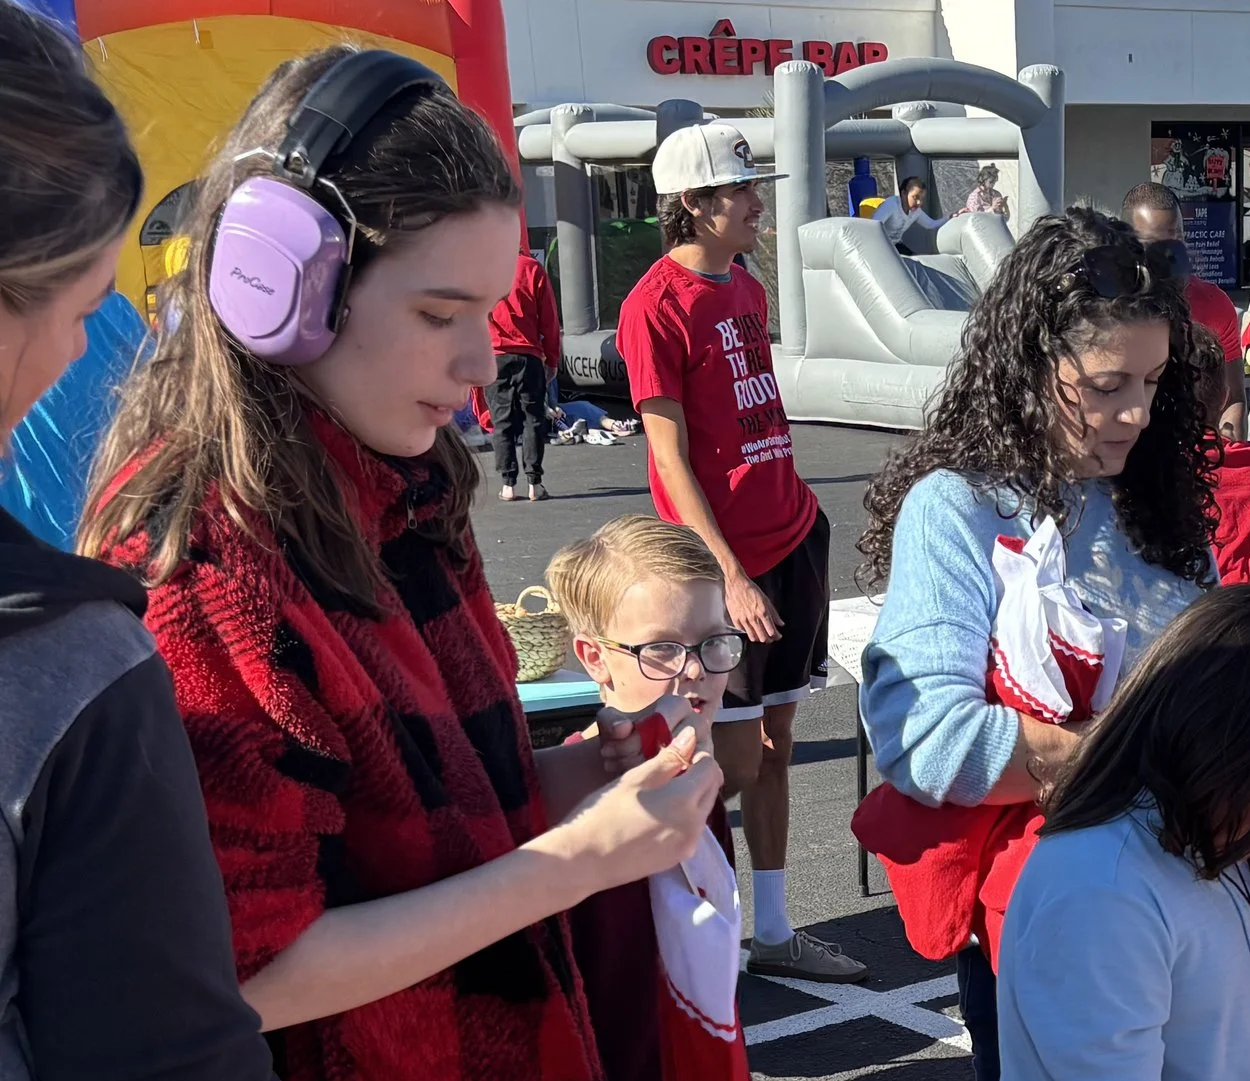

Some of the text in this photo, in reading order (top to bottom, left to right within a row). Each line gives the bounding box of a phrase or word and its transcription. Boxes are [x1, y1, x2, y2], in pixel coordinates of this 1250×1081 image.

[647, 18, 793, 76] CRÊPE
[229, 266, 276, 297] ProCase
[558, 354, 627, 382] UNCEHOUS
